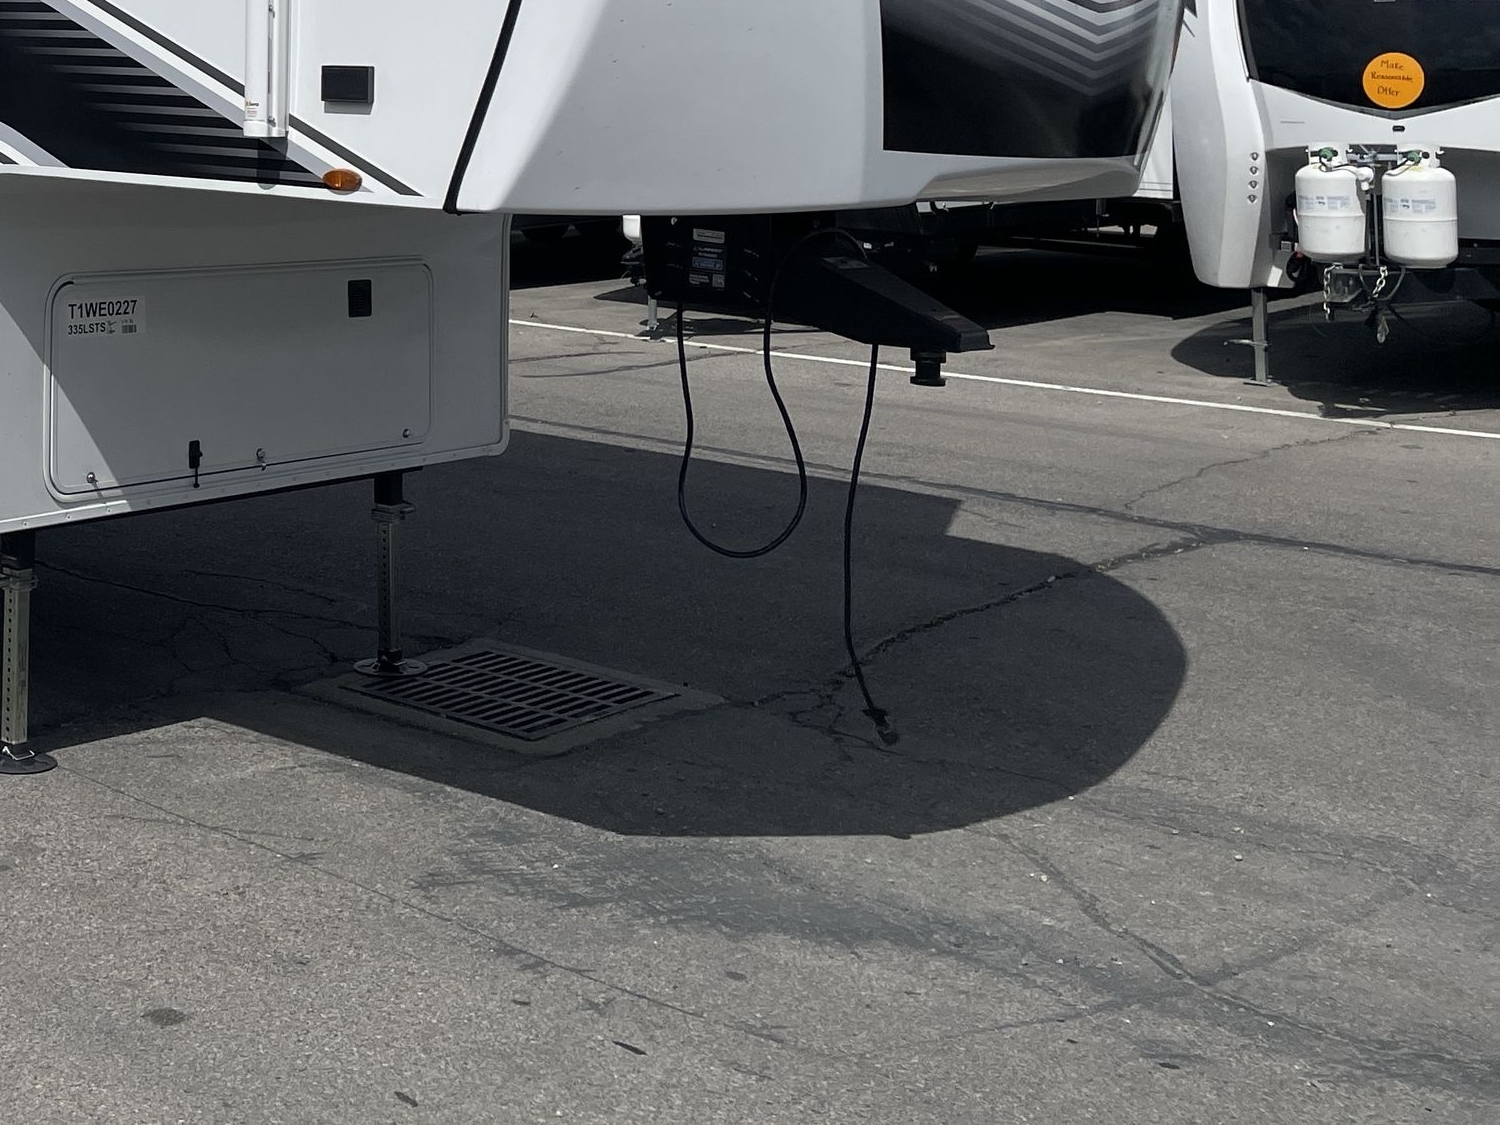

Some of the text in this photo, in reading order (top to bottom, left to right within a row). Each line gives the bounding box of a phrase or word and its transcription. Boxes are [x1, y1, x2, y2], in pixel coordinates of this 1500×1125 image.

[1380, 60, 1404, 71] Make
[67, 299, 138, 320] T1WE0227
[67, 321, 106, 335] 335LSTS
